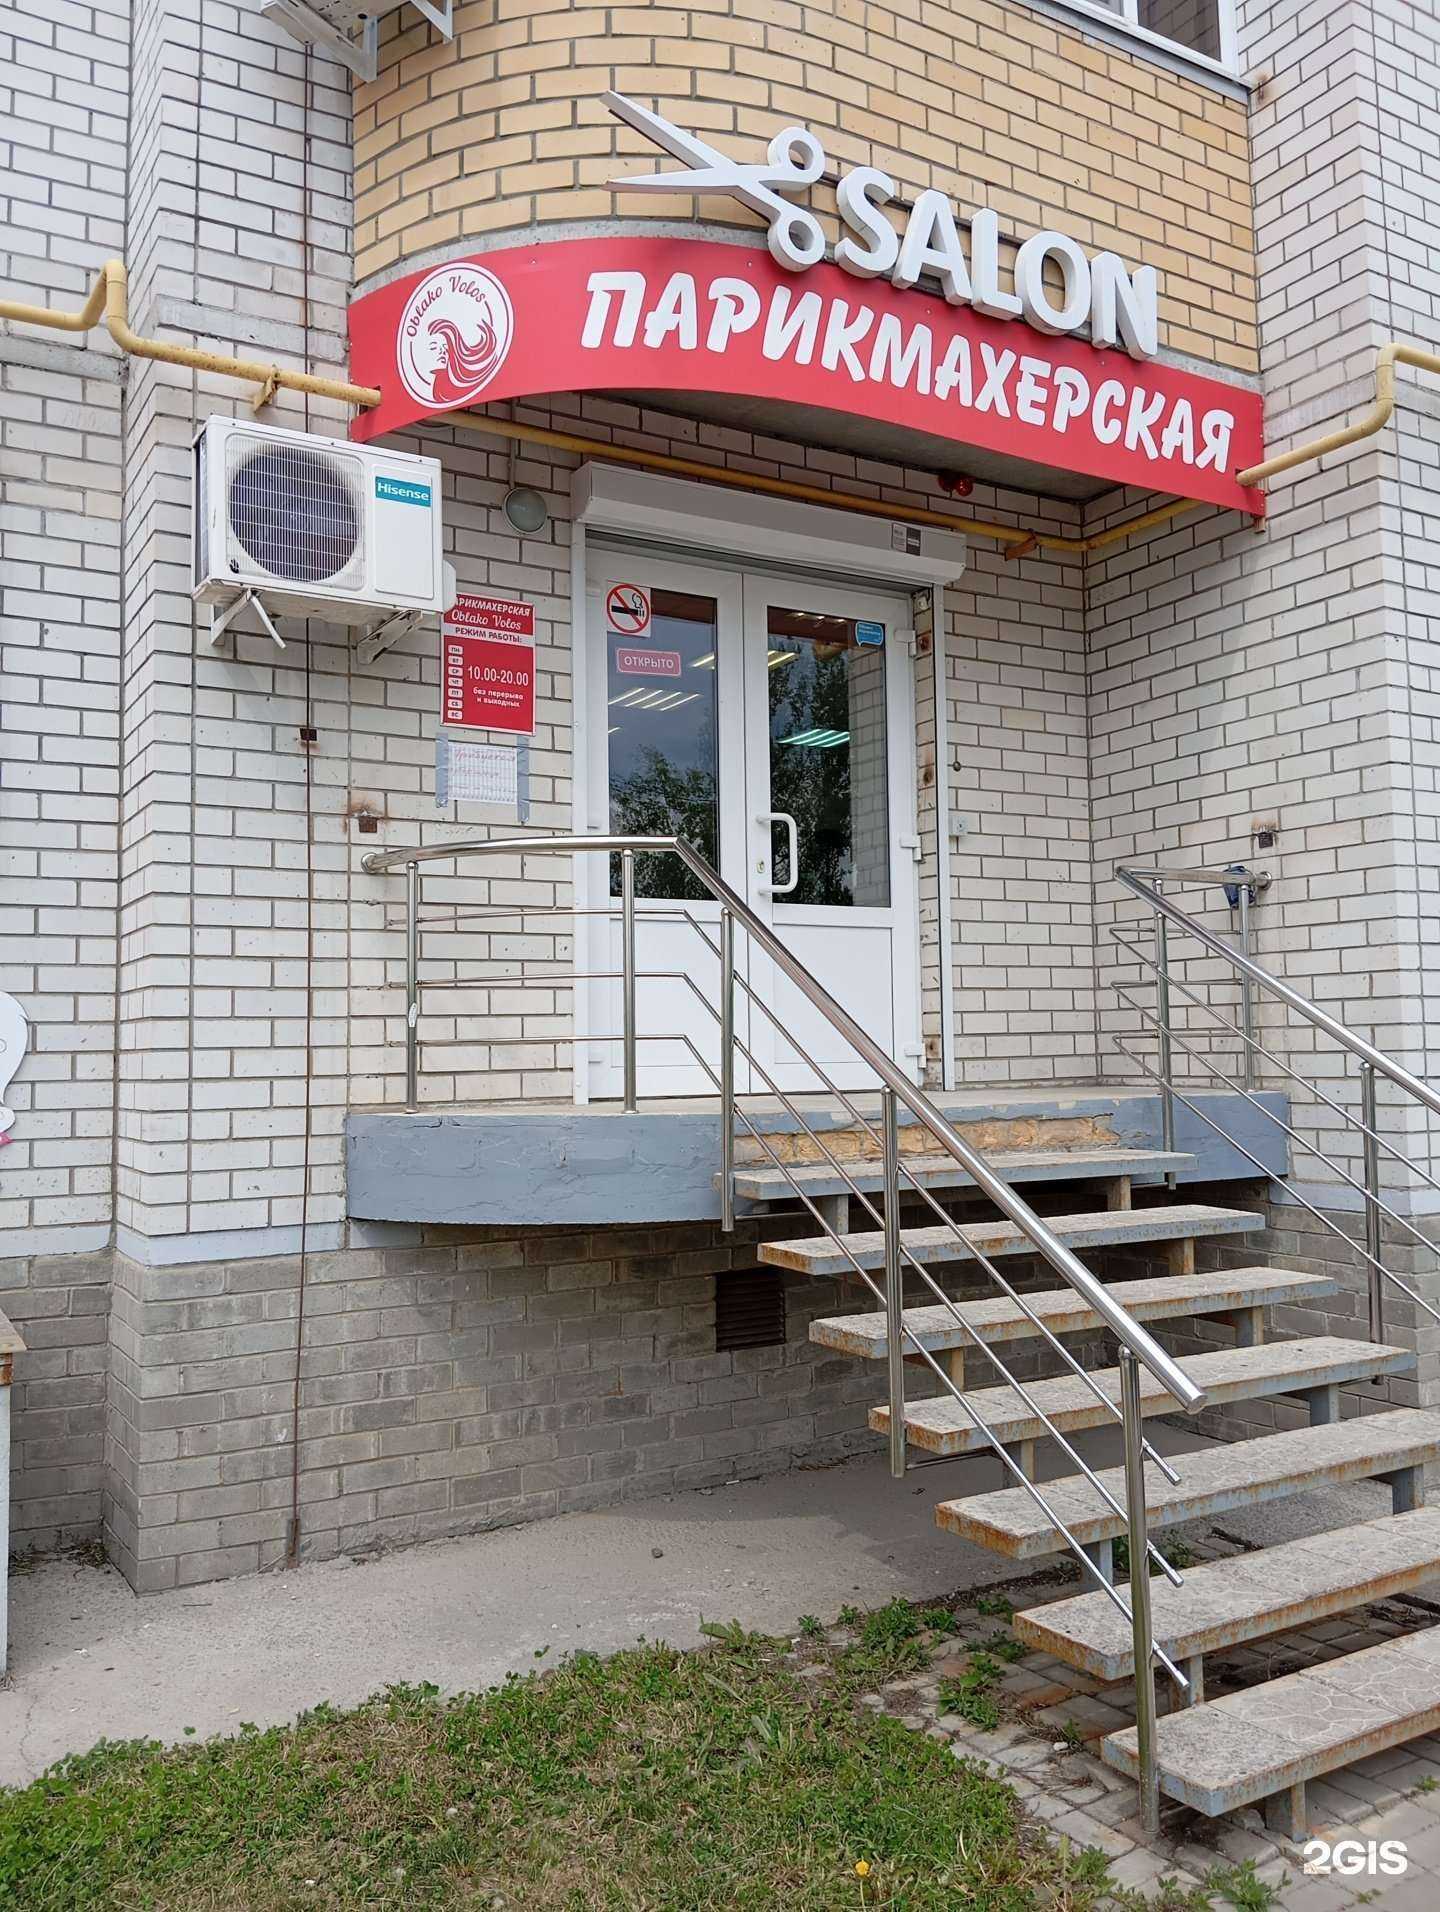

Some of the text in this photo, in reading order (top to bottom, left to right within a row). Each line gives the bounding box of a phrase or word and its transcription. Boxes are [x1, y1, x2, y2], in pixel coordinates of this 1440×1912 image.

[834, 166, 1157, 360] SALON
[406, 275, 486, 337] Oblako Volos
[580, 270, 1235, 474] ПАРИКМАХЕРСКАЯ
[376, 482, 430, 501] Hisense
[451, 609, 521, 630] Oblako Volos
[455, 627, 522, 643] РЕЖИМ РАБОТЫ:
[623, 656, 674, 669] ОТКРЫТО
[468, 665, 529, 686] 10.00-20.00
[473, 687, 523, 700] без перерыва
[484, 698, 520, 708] выходных
